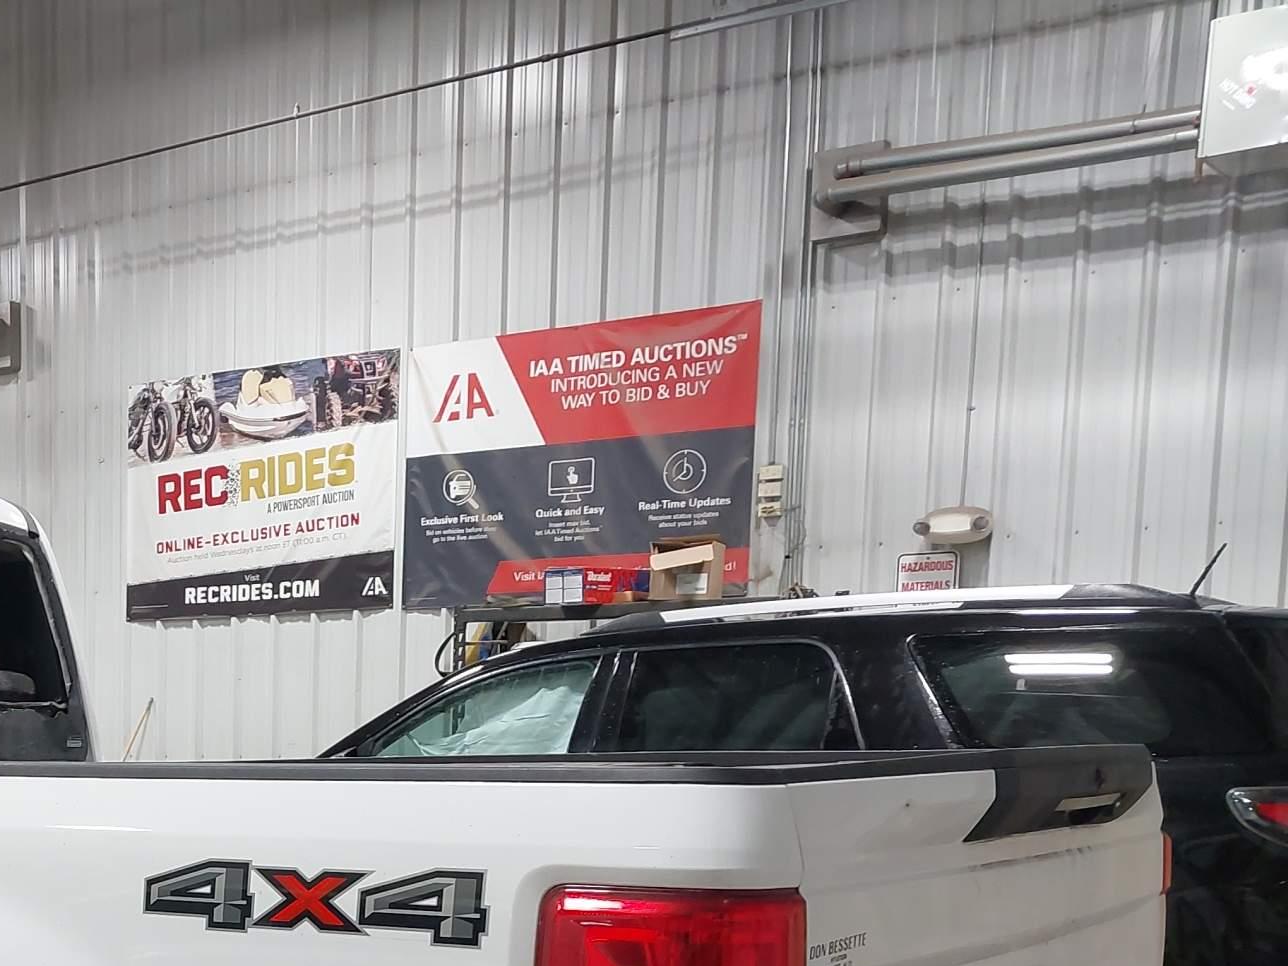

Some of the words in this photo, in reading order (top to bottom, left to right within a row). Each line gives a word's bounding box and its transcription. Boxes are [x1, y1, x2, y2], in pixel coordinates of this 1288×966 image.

[528, 358, 563, 377] IAA
[566, 350, 625, 374] TIMED
[550, 366, 661, 393] INTRODUCING
[664, 364, 678, 380] A
[679, 359, 724, 379] NEW
[561, 393, 594, 410] WAY
[599, 390, 622, 406] TO
[625, 385, 652, 403] BID
[656, 384, 670, 400] &
[675, 379, 711, 398] BUY
[157, 465, 230, 515] REC
[240, 442, 356, 502] RIDES
[266, 502, 272, 514] A
[273, 496, 320, 513] POWERSPORT
[322, 490, 355, 505] AUCTION
[535, 508, 562, 518] Quick
[564, 506, 582, 516] and
[583, 505, 605, 515] Easy
[638, 499, 686, 511] Real-Time
[688, 497, 732, 509] Updates
[420, 515, 458, 526] Exclusive
[459, 513, 479, 523] First
[481, 512, 504, 521] Look
[156, 523, 292, 554] ONLINE-EXCLUSIVE
[295, 513, 361, 534] AUCTION
[244, 574, 260, 583] Visit
[513, 571, 535, 582] Visit
[900, 560, 954, 573] HAZARDOUS
[184, 579, 320, 605] RECRIDES.COM
[902, 580, 951, 592] MATERIALS
[809, 943, 826, 961] DON
[828, 932, 867, 955] BESSETTE
